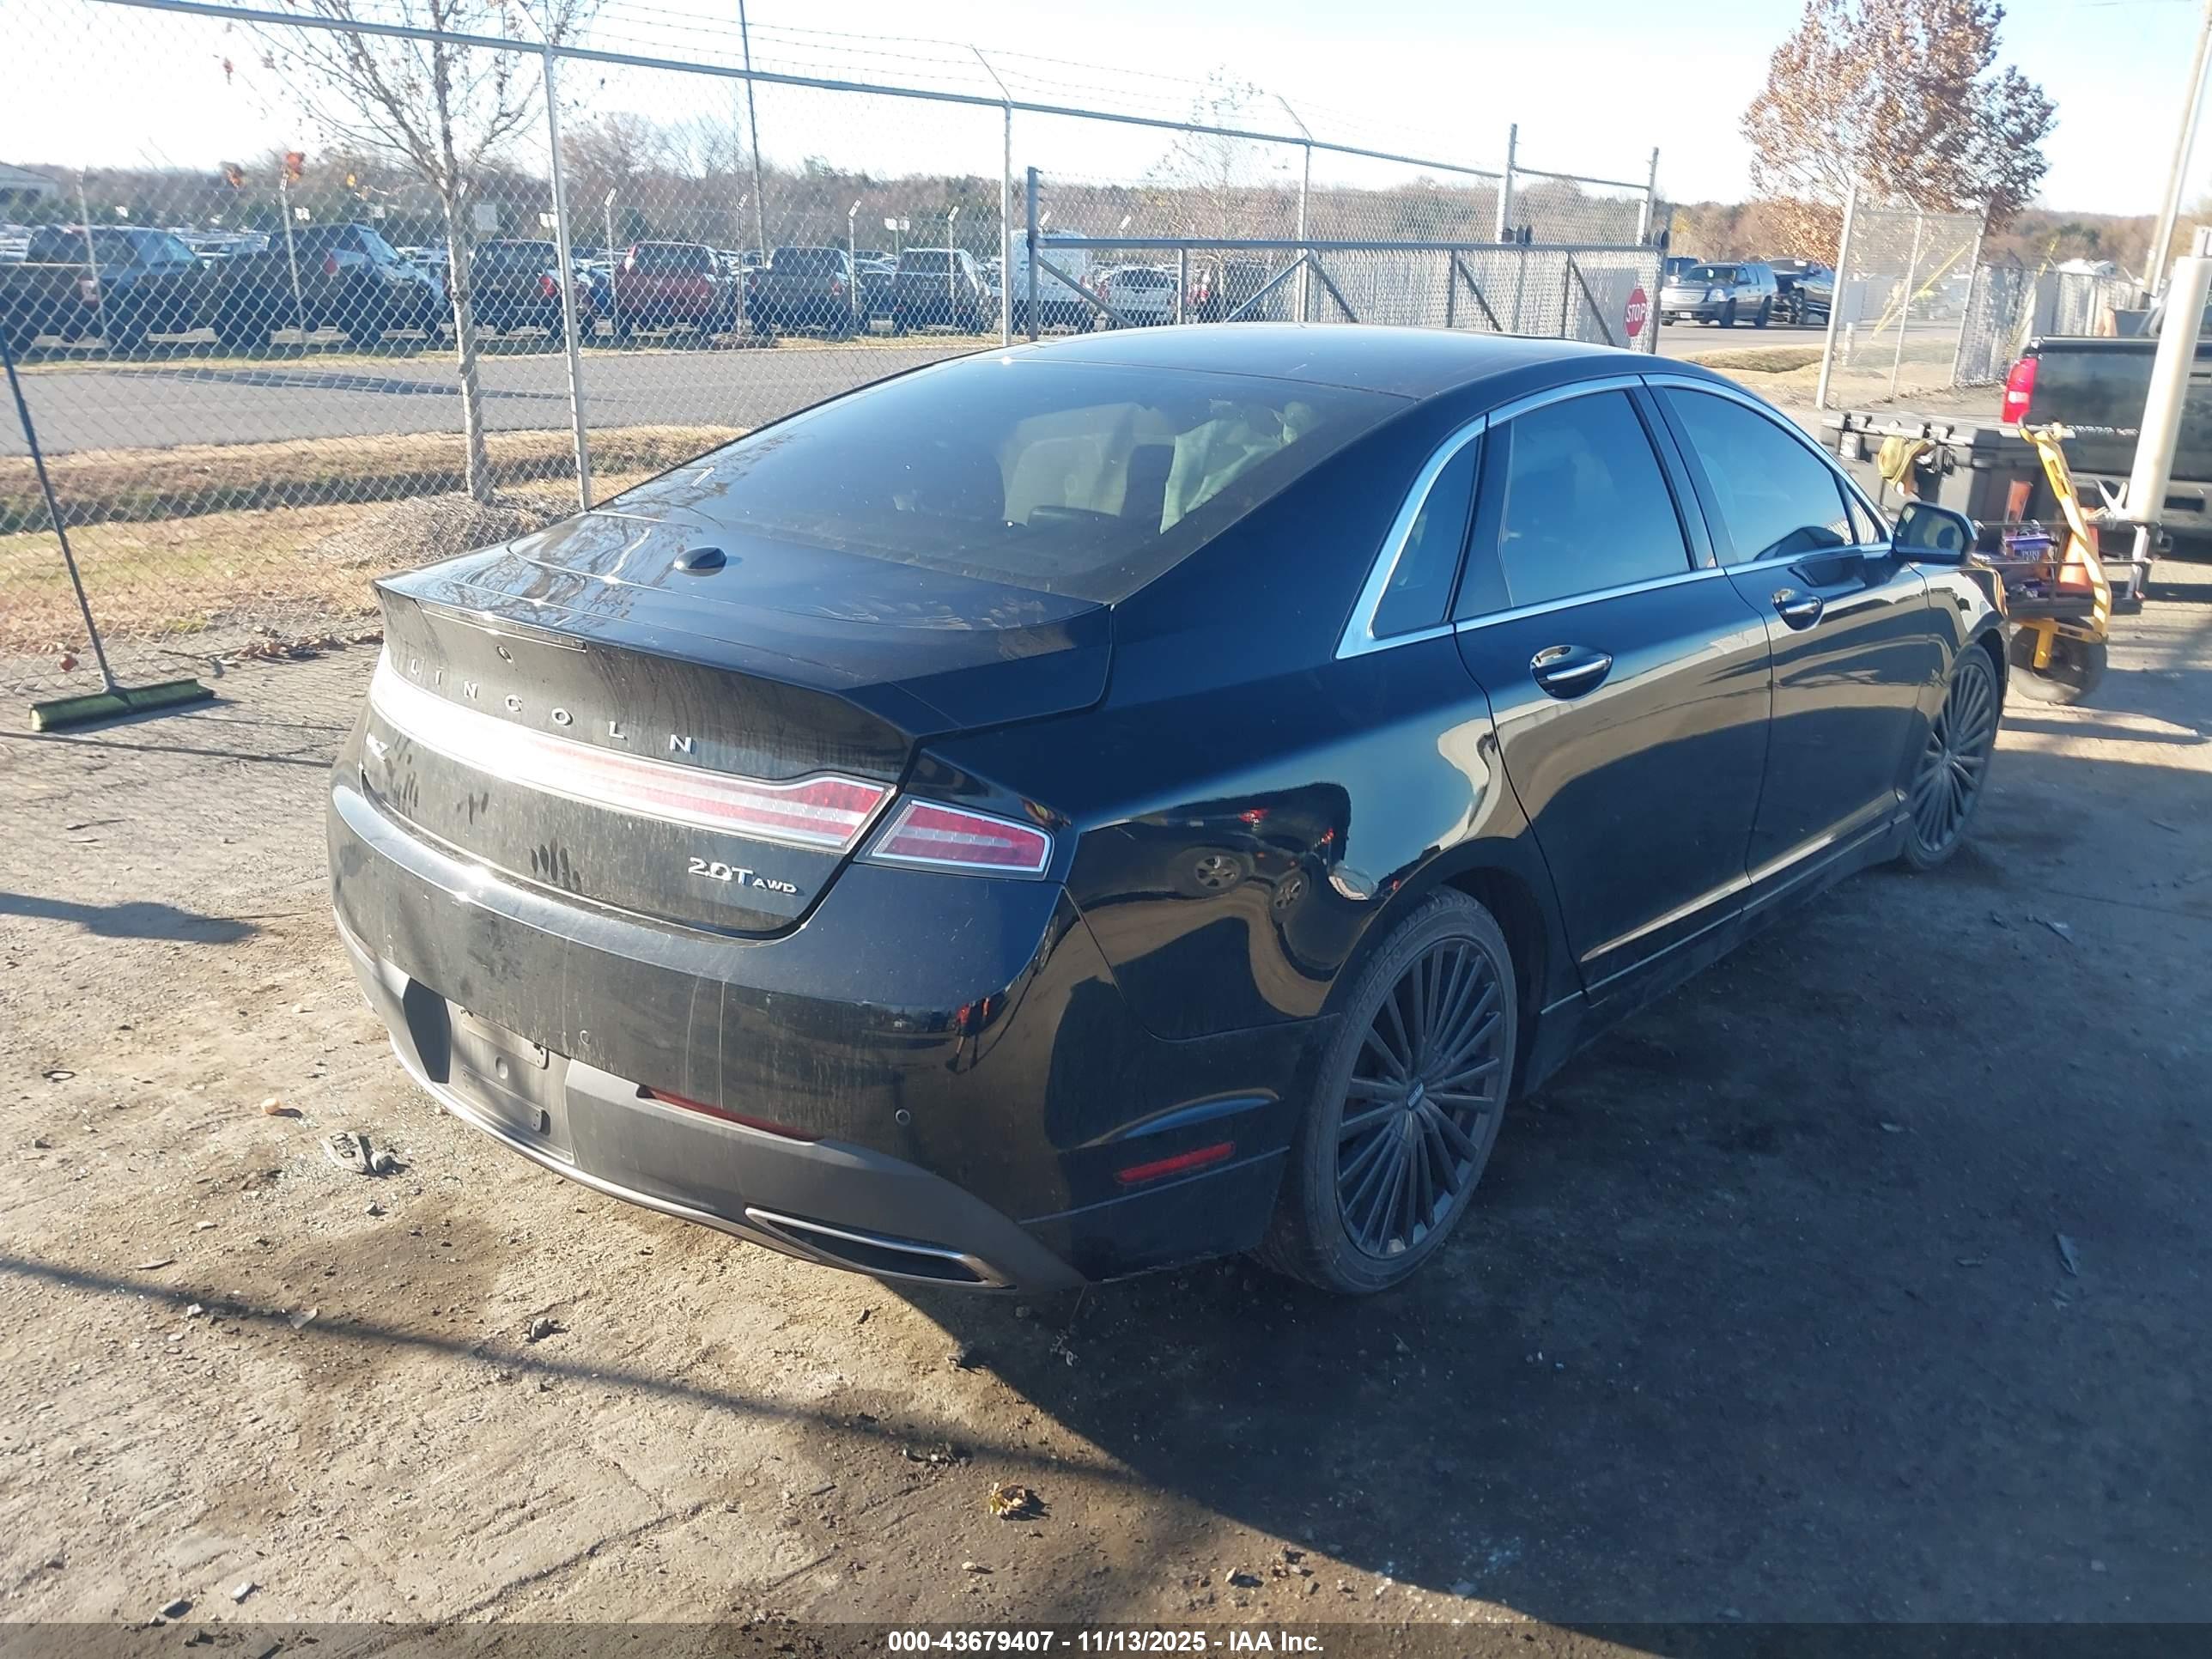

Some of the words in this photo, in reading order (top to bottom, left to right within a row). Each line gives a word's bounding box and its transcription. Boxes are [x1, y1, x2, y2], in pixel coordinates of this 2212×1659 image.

[1626, 302, 1646, 323] STOP
[410, 659, 696, 755] LINCOLN
[752, 878, 798, 894] AWD
